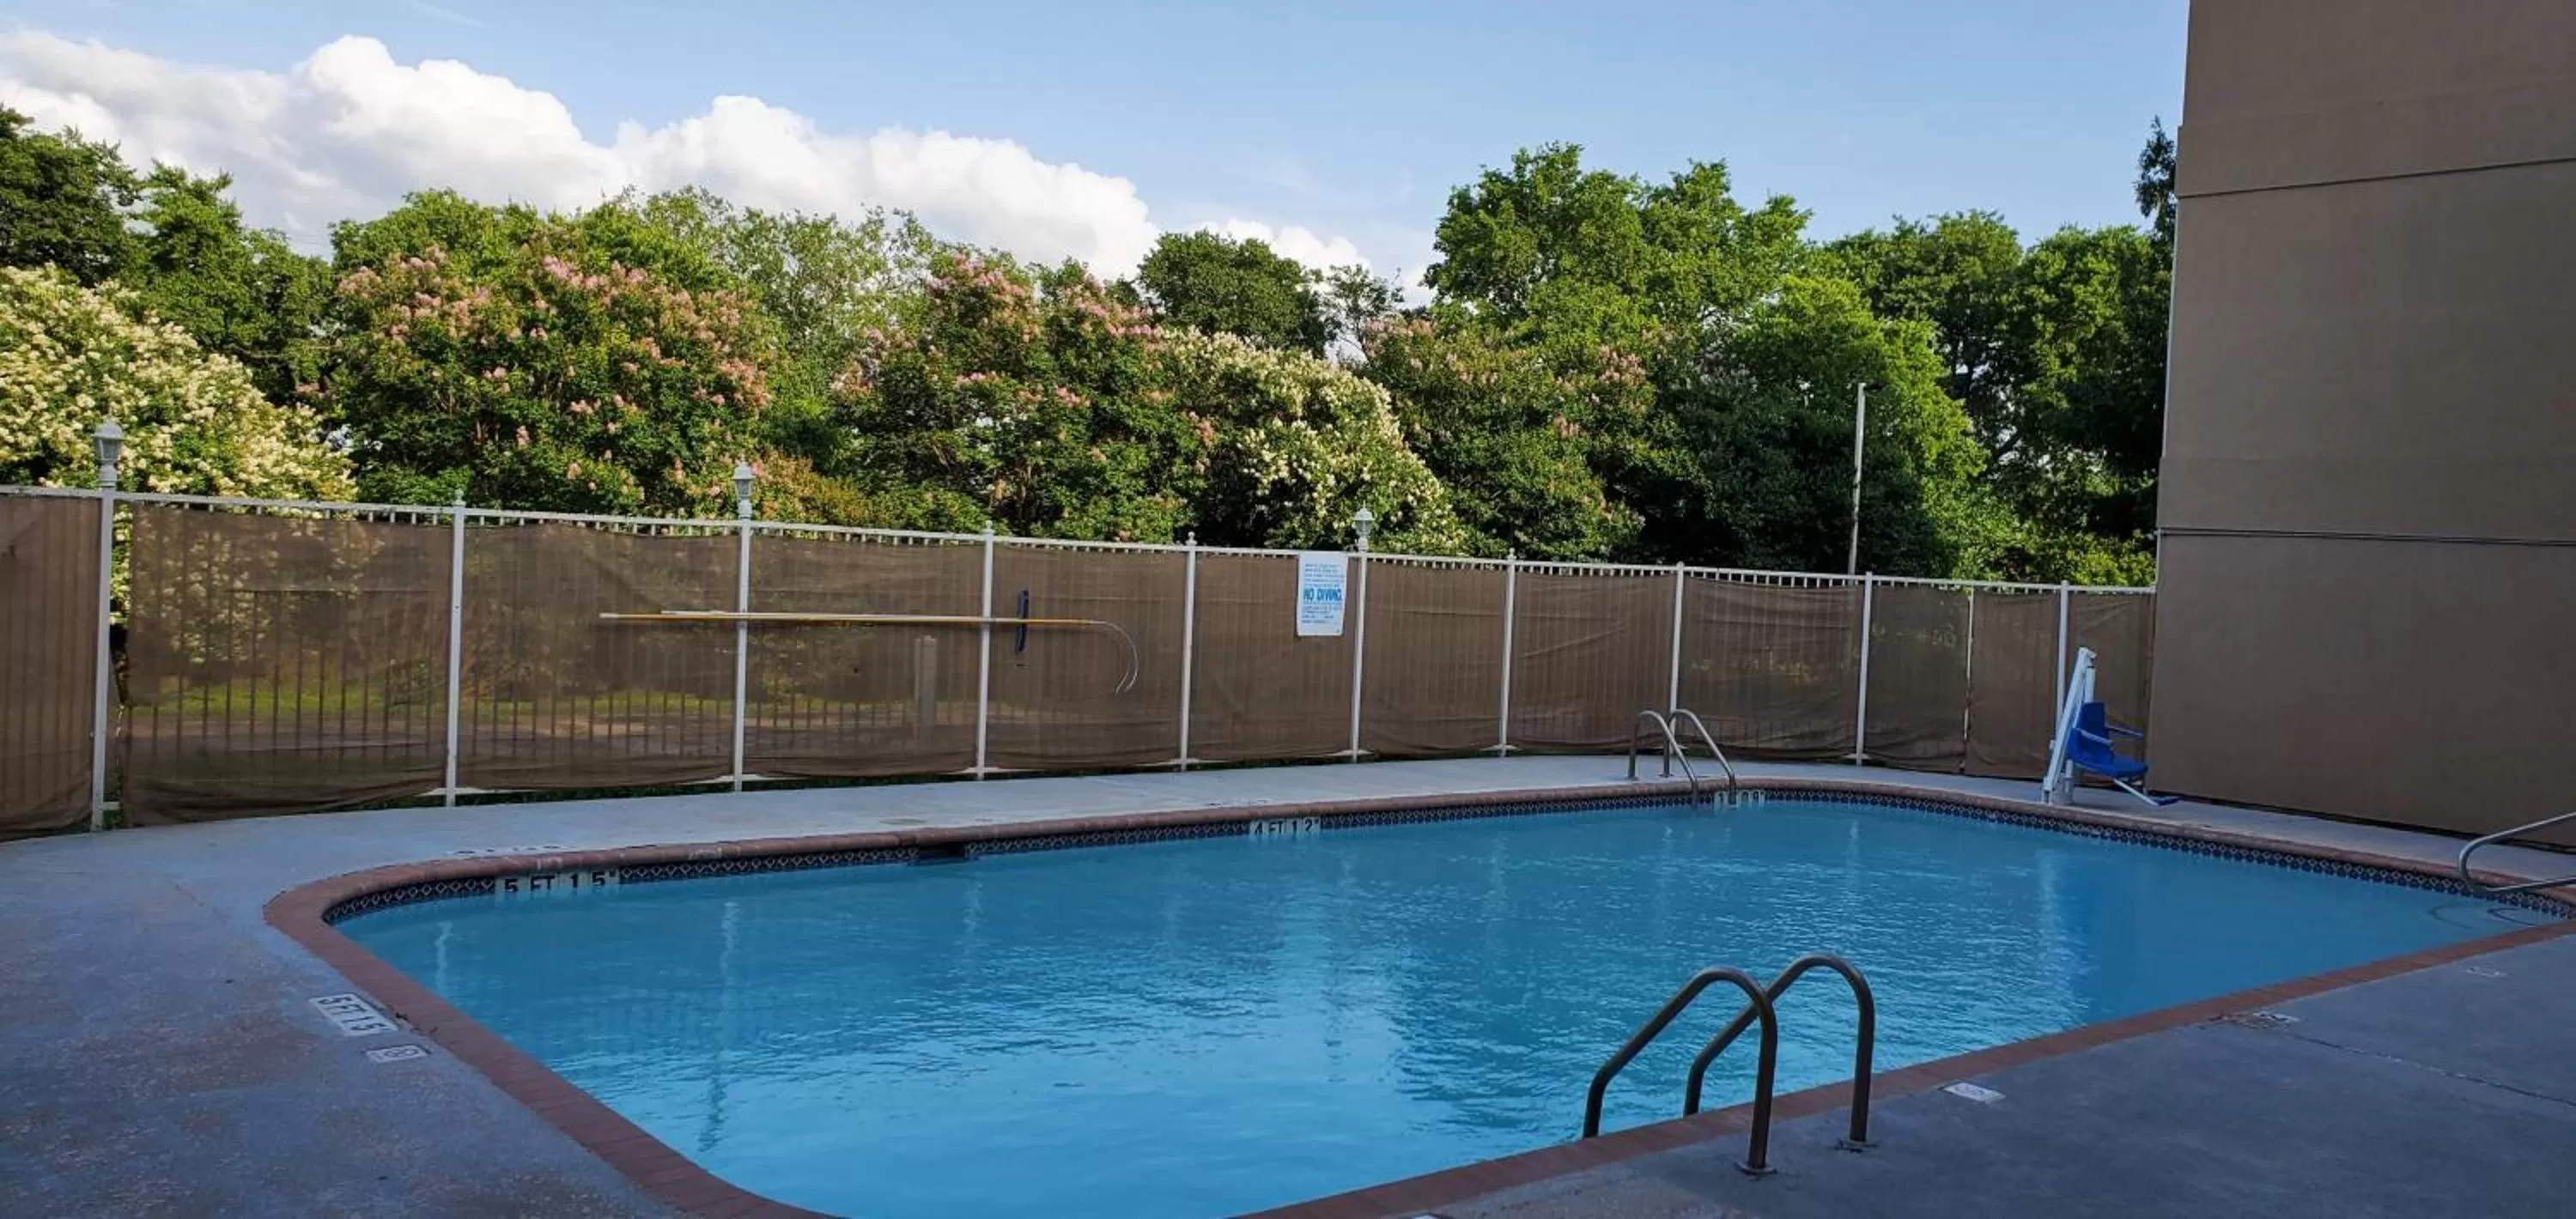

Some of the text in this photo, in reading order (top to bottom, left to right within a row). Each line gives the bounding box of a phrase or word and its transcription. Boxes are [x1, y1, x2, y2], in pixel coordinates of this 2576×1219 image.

[1303, 588, 1342, 602] NO DIVING
[530, 874, 556, 892] FT
